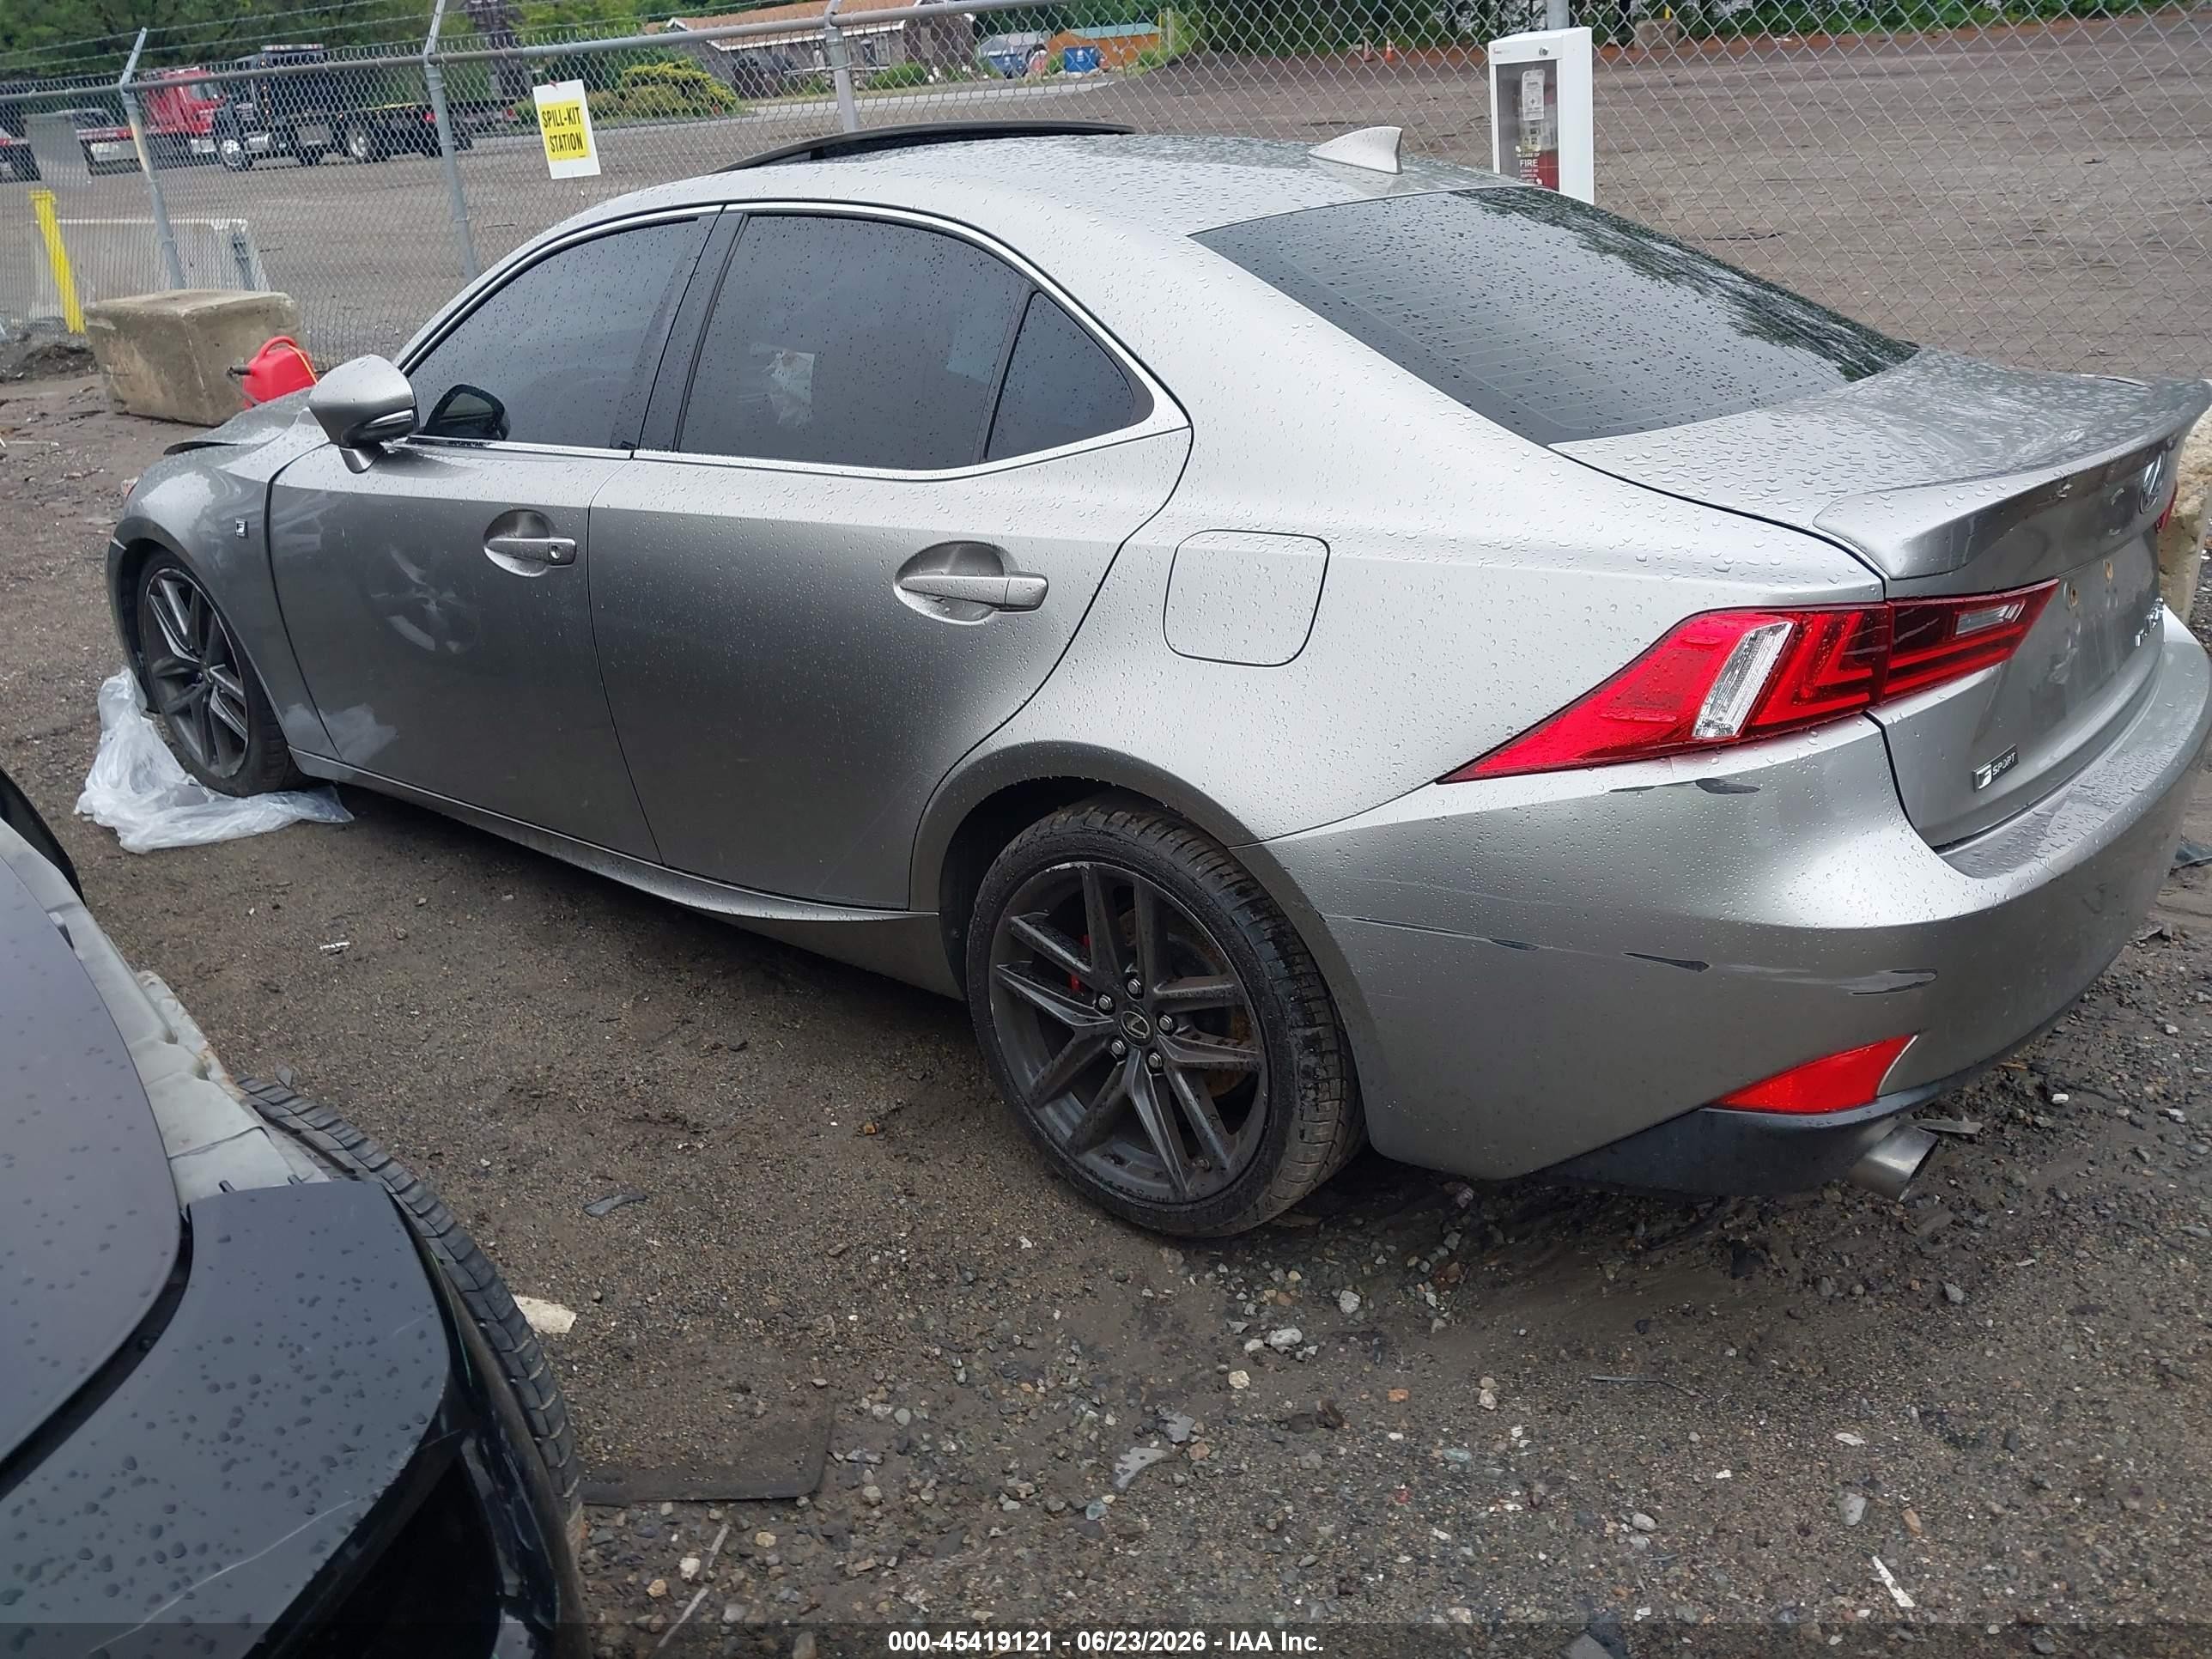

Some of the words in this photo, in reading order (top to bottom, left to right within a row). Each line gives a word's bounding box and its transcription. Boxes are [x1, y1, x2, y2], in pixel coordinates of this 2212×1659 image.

[542, 107, 580, 128] SPILL-KIT
[550, 132, 583, 153] STATION
[1992, 752, 2016, 775] SPORT
